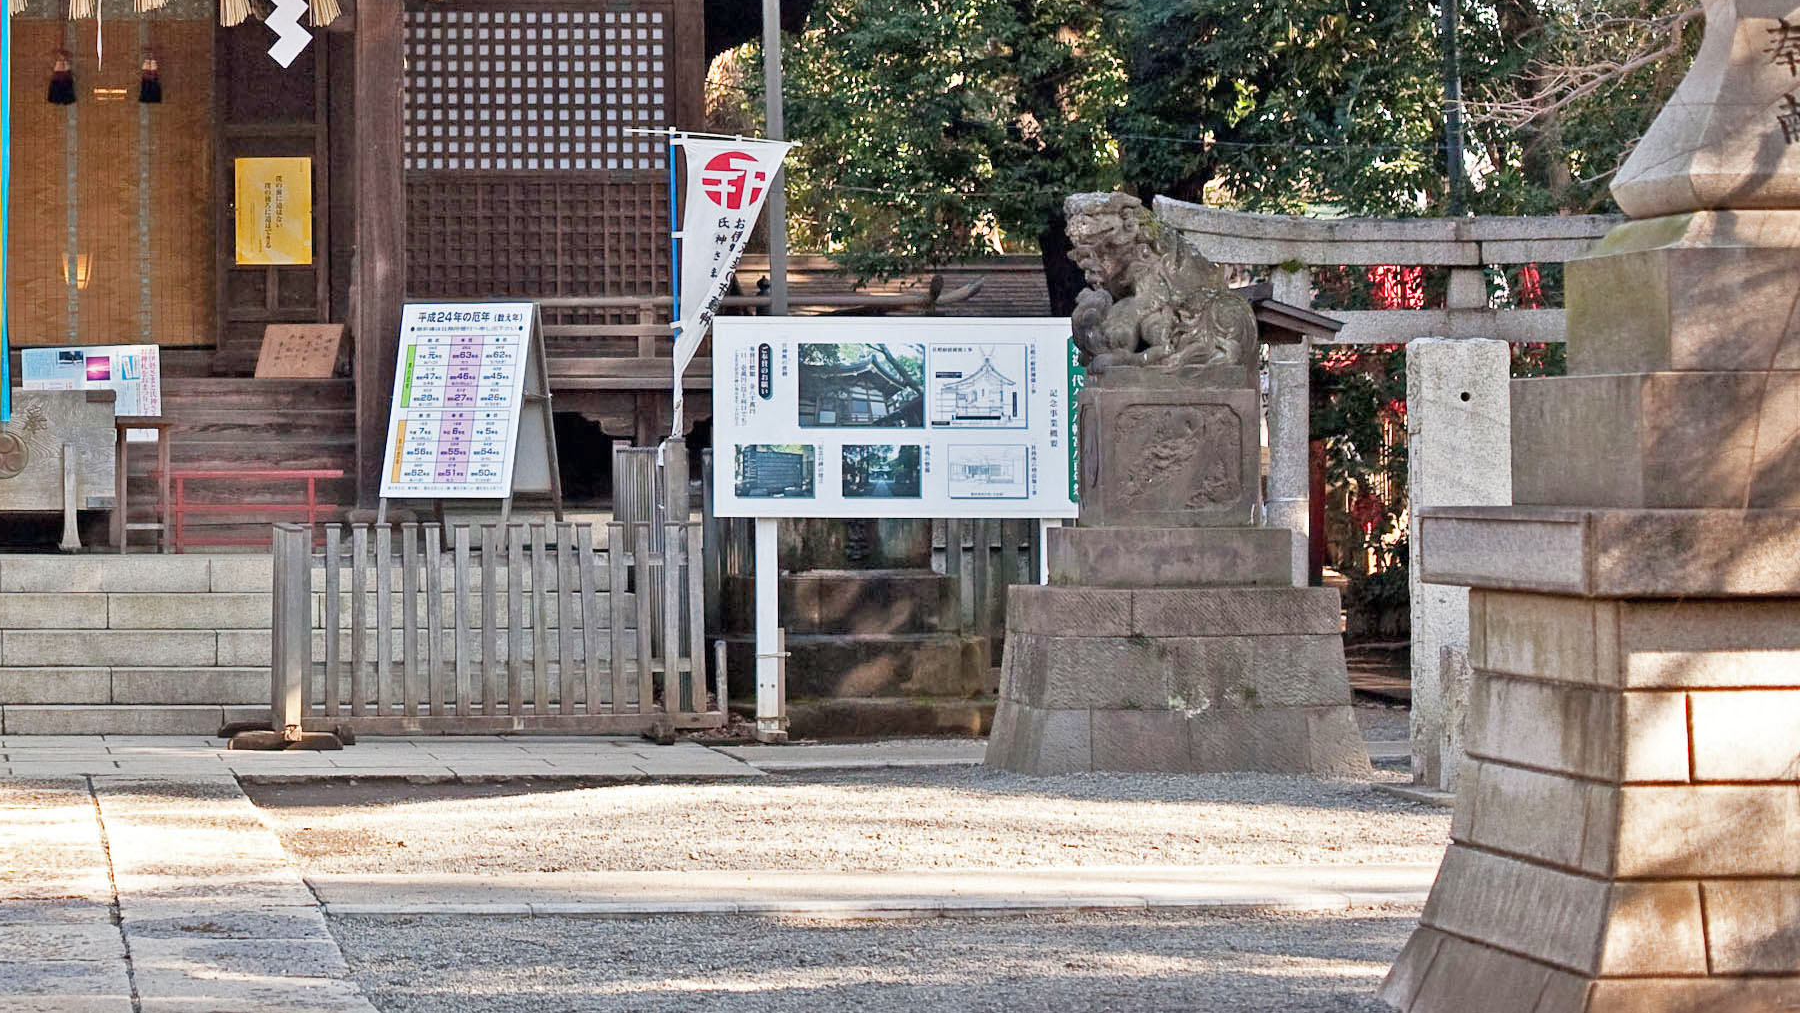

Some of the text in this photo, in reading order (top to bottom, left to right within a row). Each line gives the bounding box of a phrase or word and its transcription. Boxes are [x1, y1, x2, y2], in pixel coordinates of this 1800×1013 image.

[710, 217, 730, 278] 氏神さま
[418, 312, 490, 323] 平成24年の厄年
